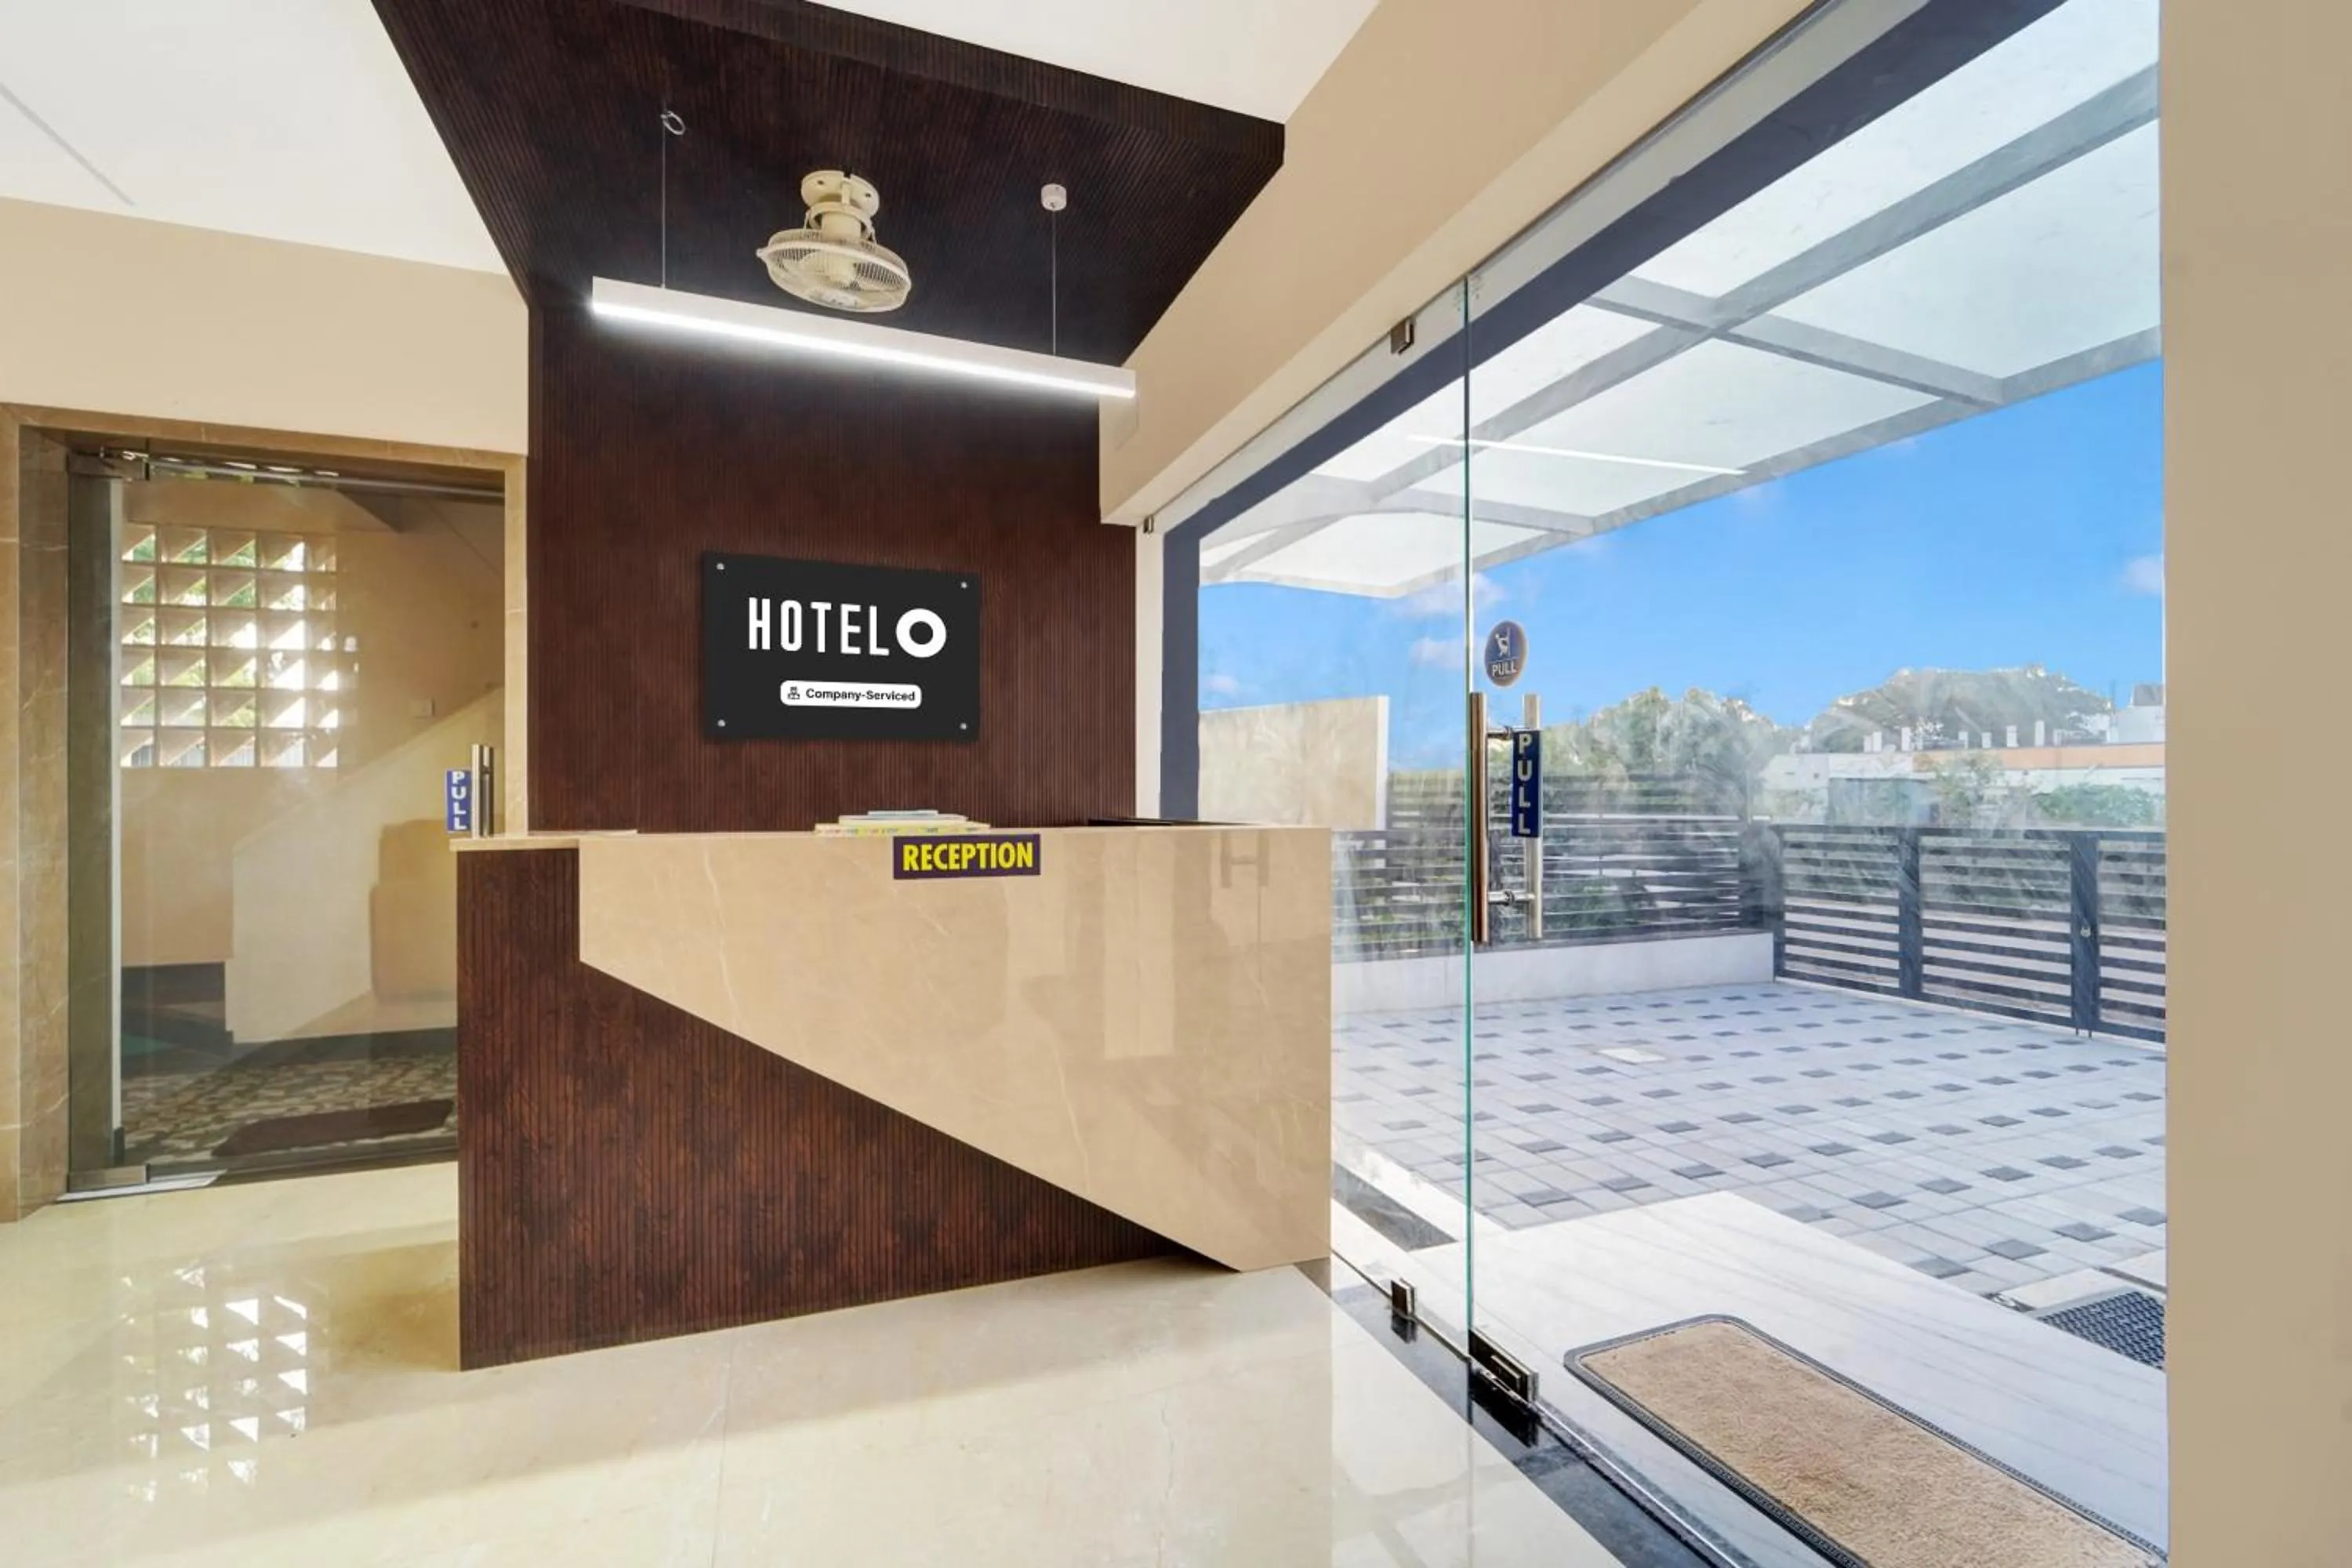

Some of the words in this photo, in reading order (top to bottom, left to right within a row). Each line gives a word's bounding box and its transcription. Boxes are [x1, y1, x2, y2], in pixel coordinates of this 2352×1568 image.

[749, 597, 890, 656] HOTEL
[1492, 661, 1518, 677] PULL
[805, 688, 916, 702] Company-Serviced
[451, 771, 468, 831] PULL
[1517, 733, 1534, 835] PULL
[902, 841, 1033, 871] RECEPTION
